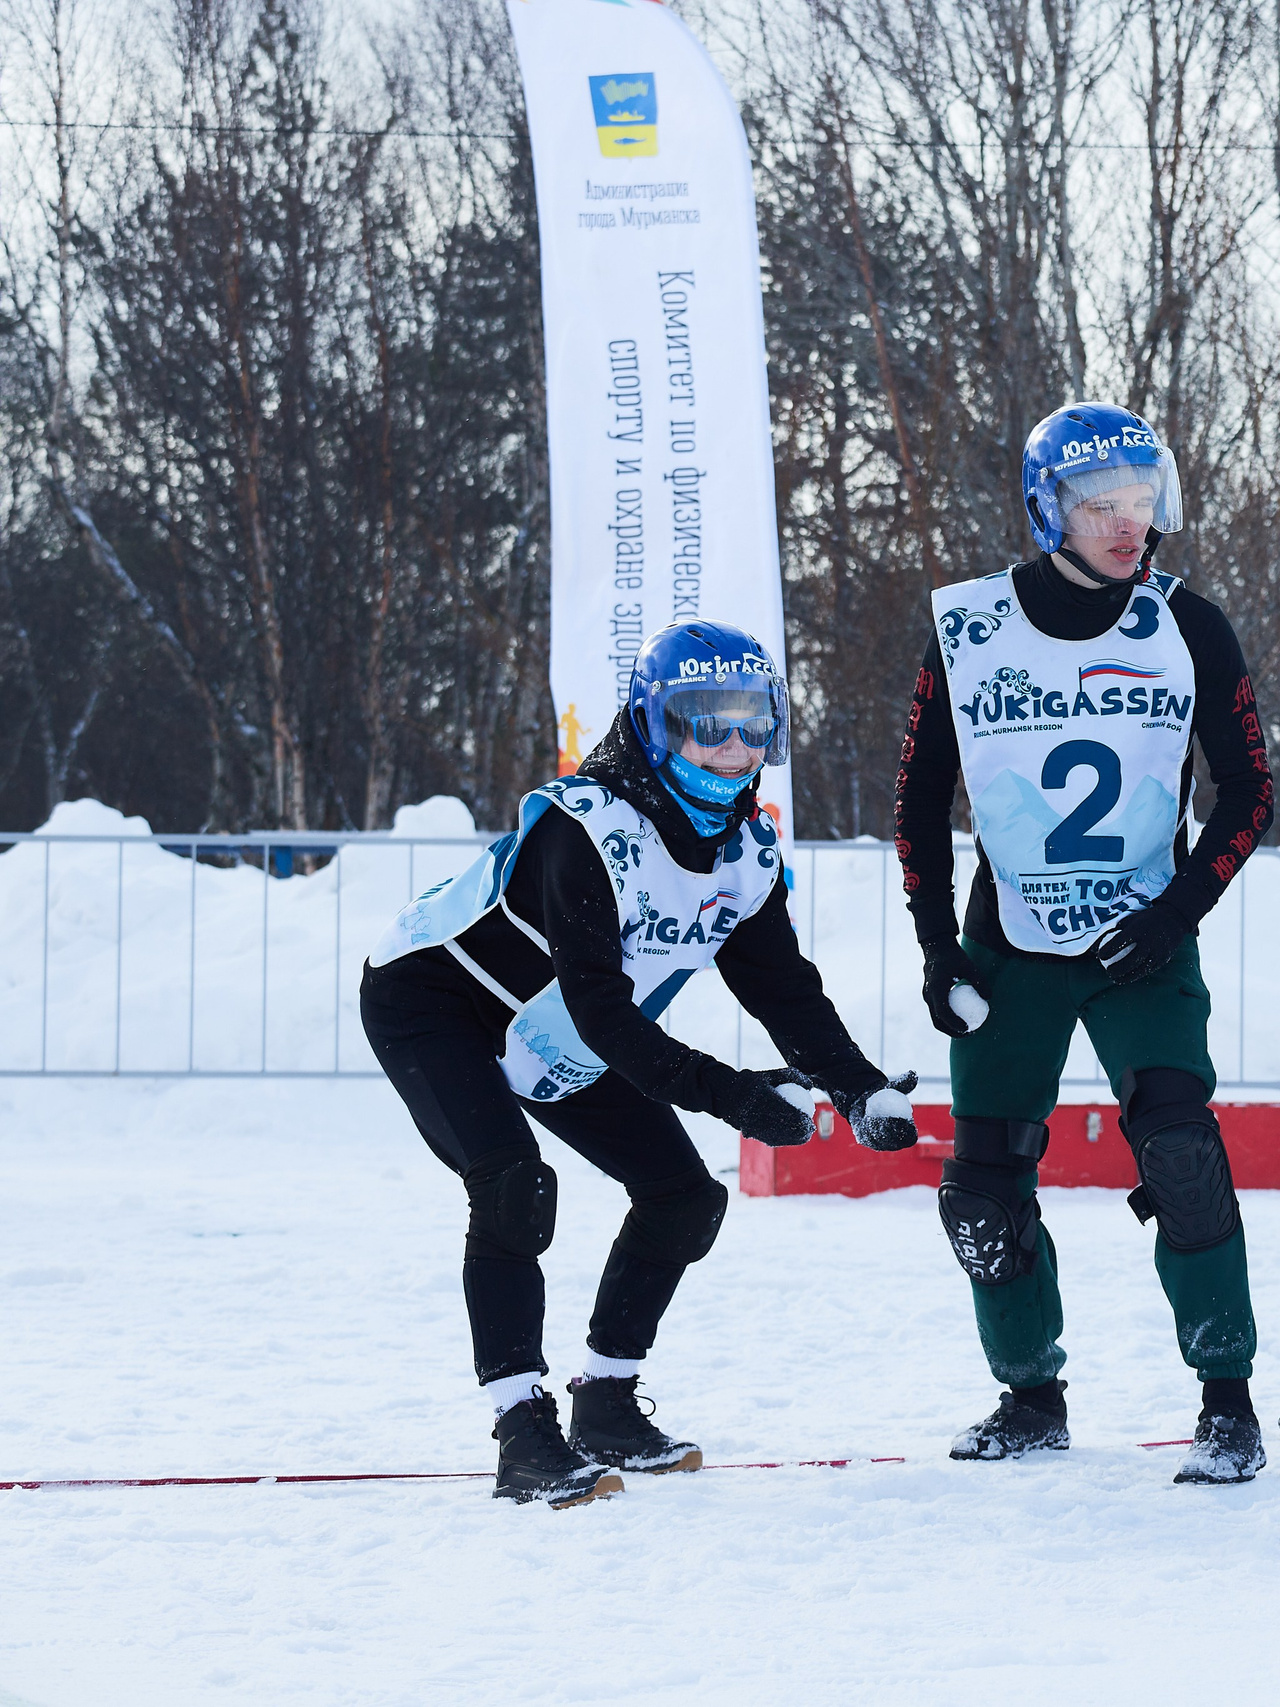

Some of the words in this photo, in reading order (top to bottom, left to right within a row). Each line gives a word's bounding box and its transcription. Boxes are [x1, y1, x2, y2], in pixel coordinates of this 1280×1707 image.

[585, 179, 690, 202] Администрация
[578, 212, 617, 231] города
[620, 206, 701, 230] Мурманска
[657, 270, 697, 408] Комитет
[607, 338, 644, 444] спорту
[670, 419, 697, 454] по
[1062, 433, 1160, 461] ЮКИГАСС
[616, 457, 643, 476] и
[1054, 456, 1091, 472] МУРМАНСК
[608, 488, 645, 591] охране
[668, 676, 707, 686] МУРМАНСК
[992, 725, 1033, 735] MURMANSK
[1166, 722, 1182, 733] БОЙ
[1041, 739, 1124, 865] 2
[1021, 882, 1043, 894] ДЛЯ
[1044, 881, 1070, 893] ТЕХ,
[1040, 894, 1071, 905] ЗНАЕТ
[643, 947, 671, 955] REGION
[548, 1069, 570, 1084] КТО
[553, 1062, 581, 1078] ДЛЯ
[530, 1075, 560, 1100] В
